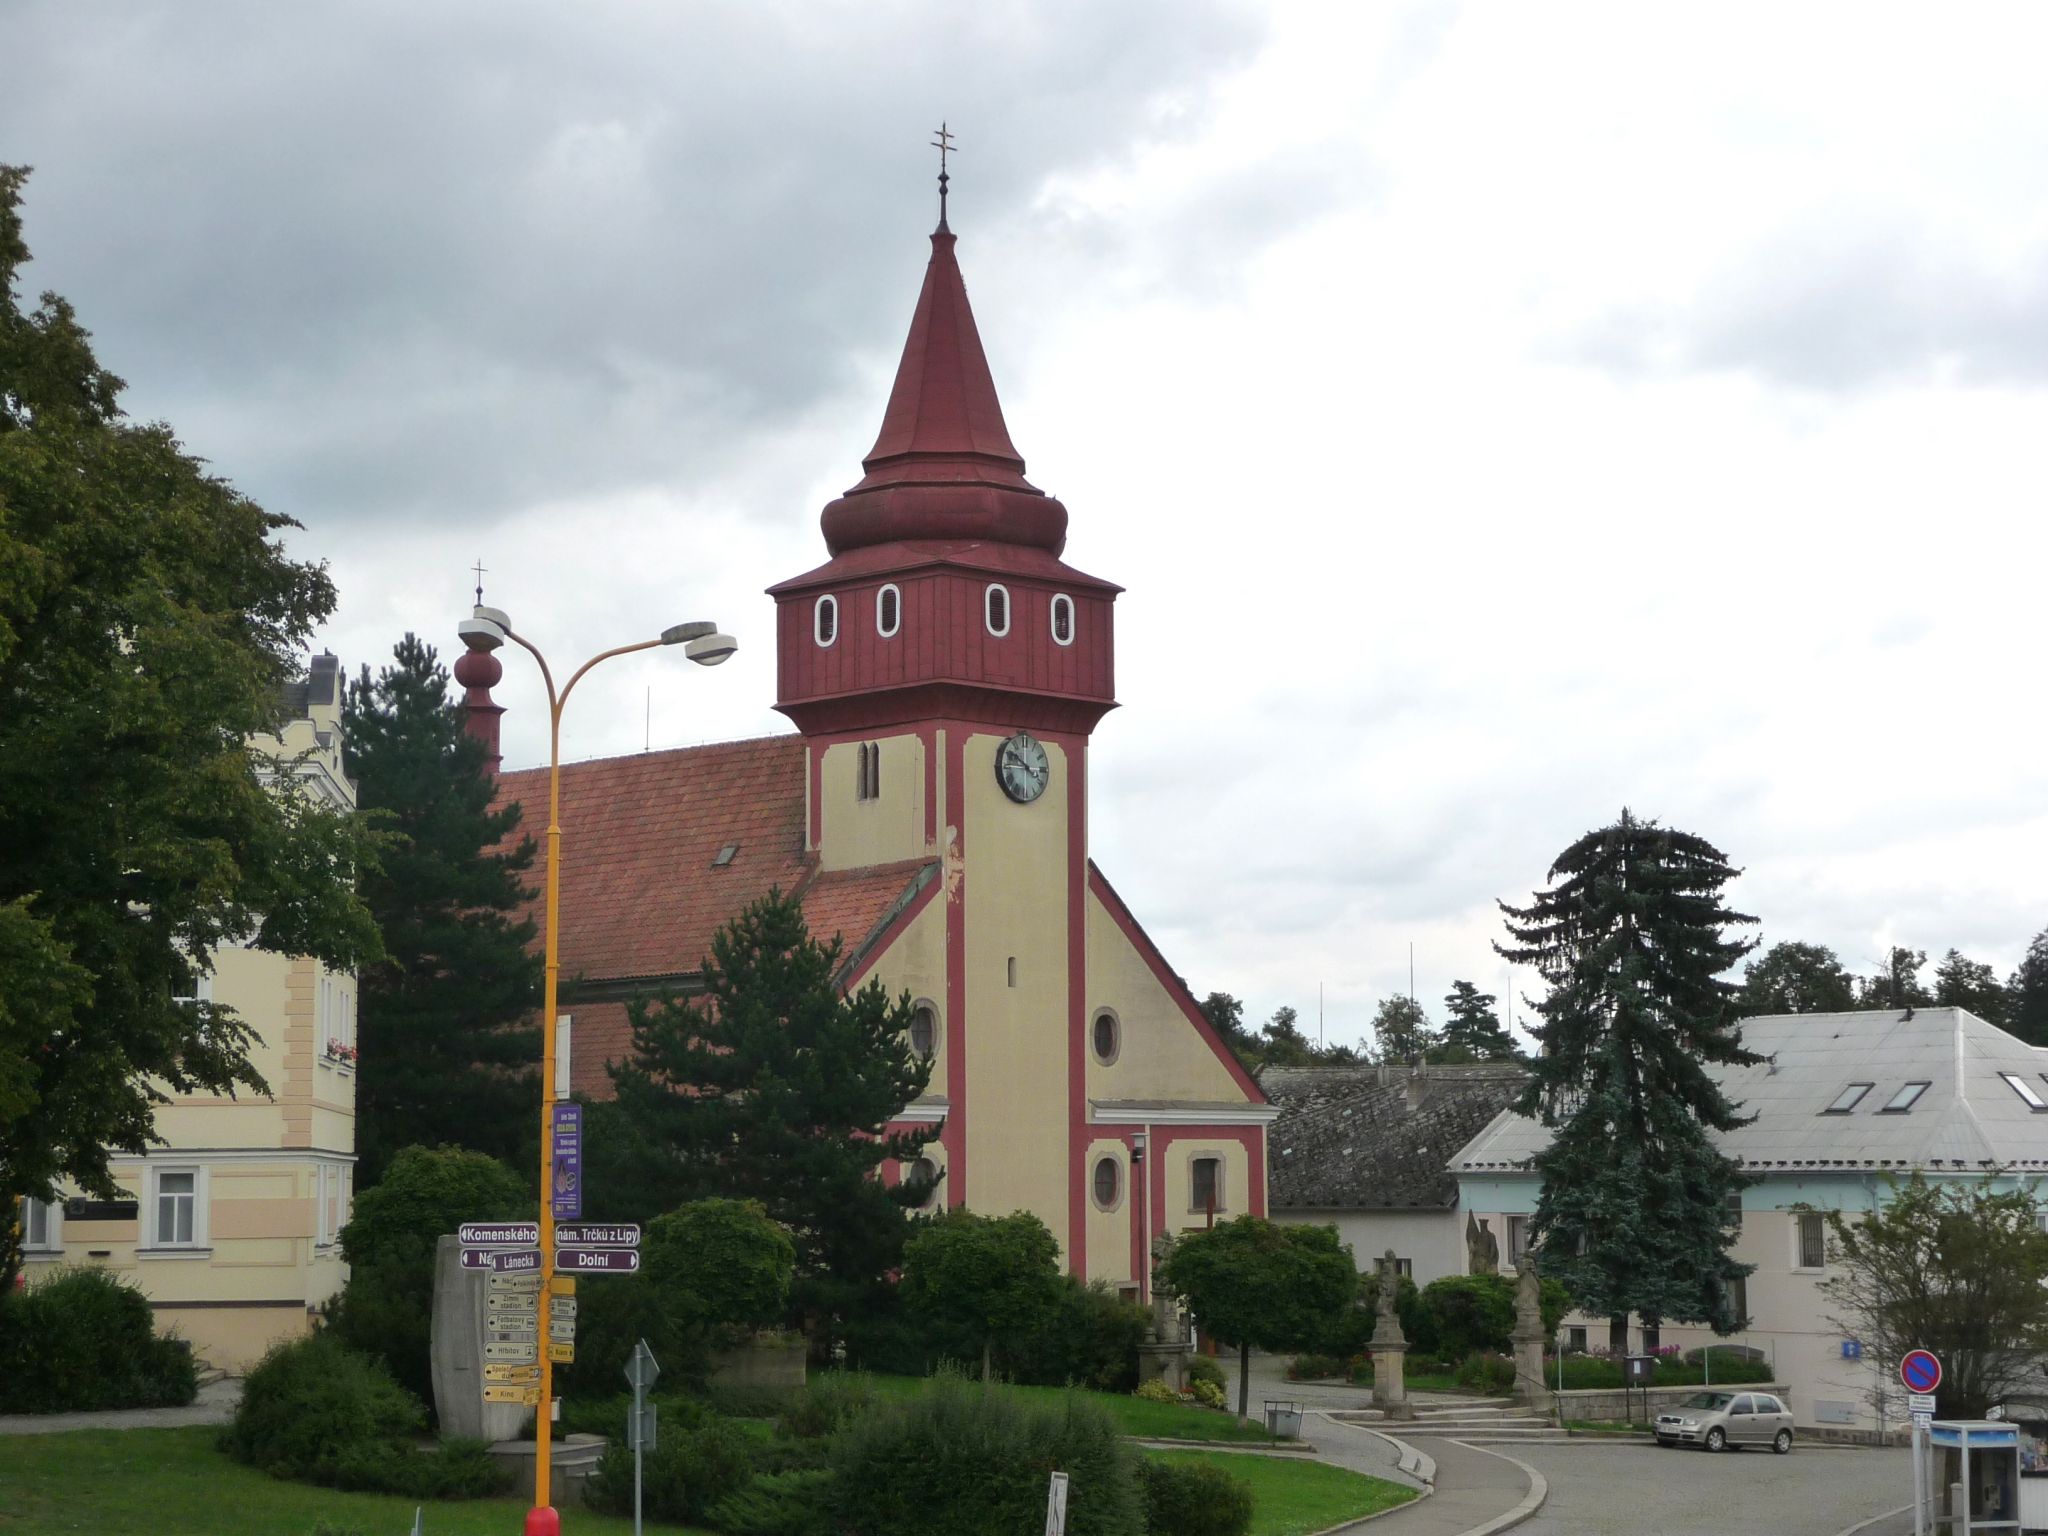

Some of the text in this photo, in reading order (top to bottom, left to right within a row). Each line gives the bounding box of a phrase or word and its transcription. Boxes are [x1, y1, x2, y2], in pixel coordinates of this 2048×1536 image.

[467, 1228, 537, 1241] Komenského
[557, 1228, 637, 1244] nám. Trčků z Lípy
[503, 1254, 535, 1269] Lánecká
[578, 1253, 609, 1266] Dolní
